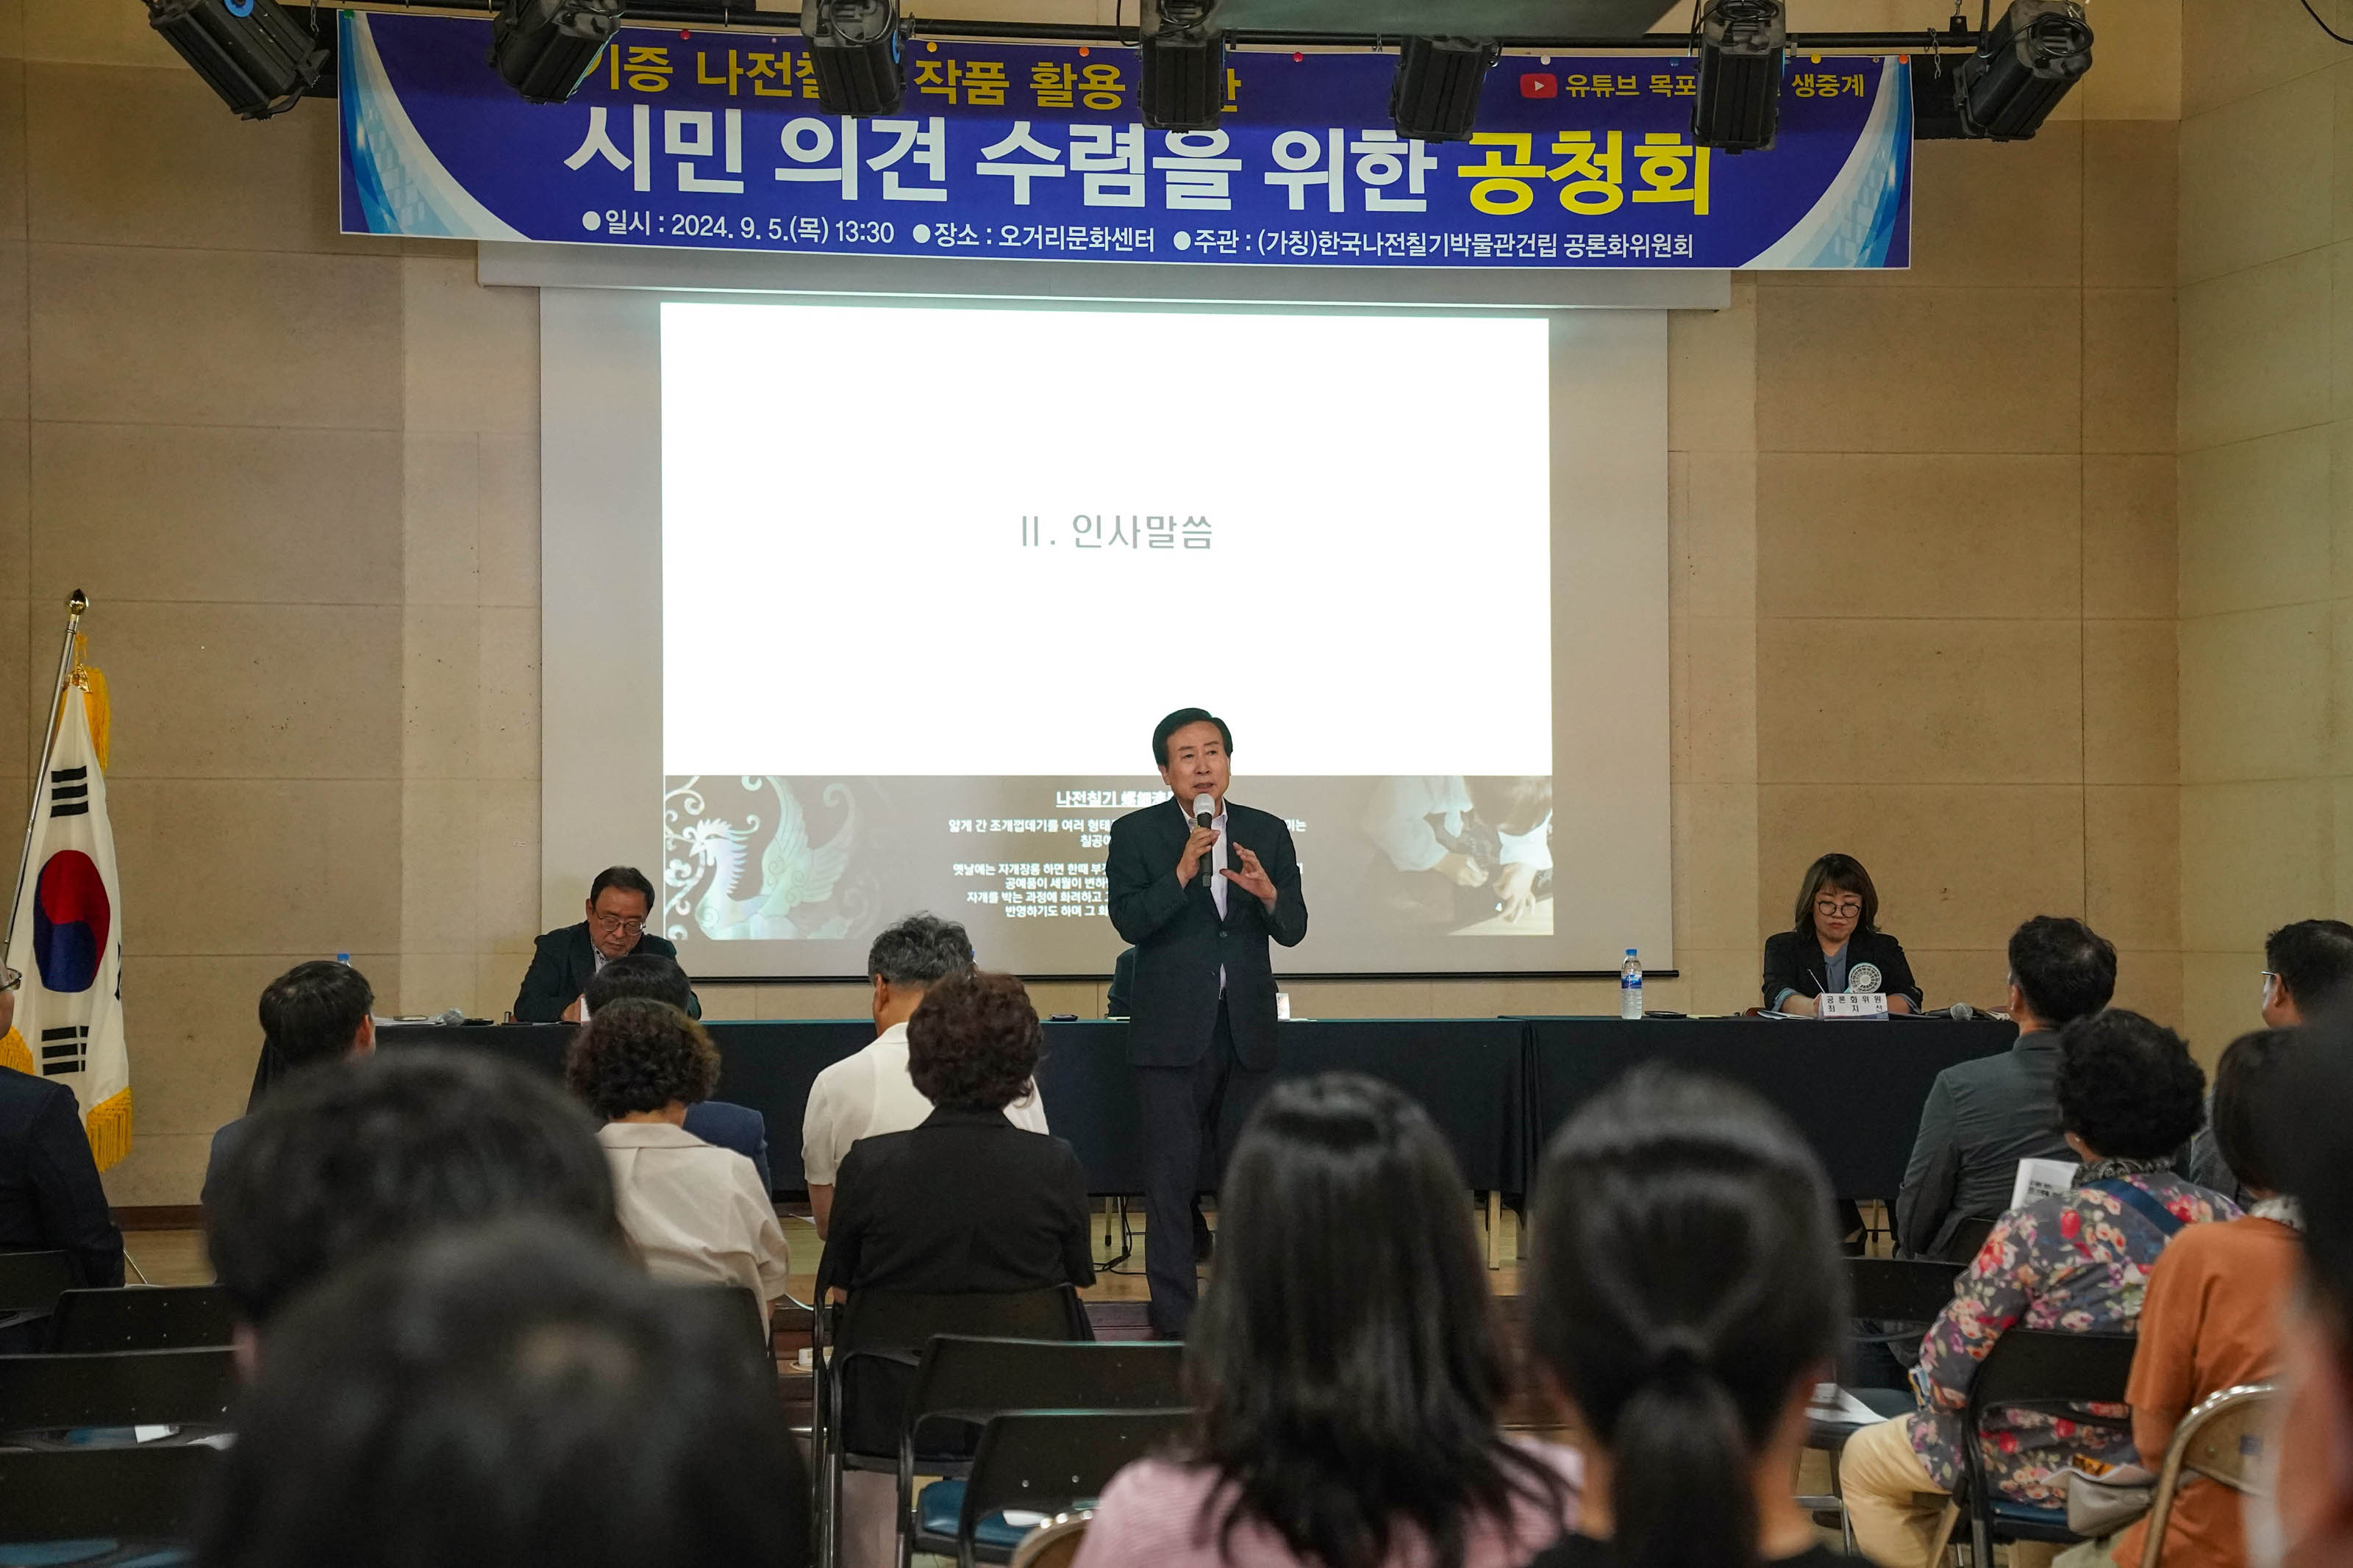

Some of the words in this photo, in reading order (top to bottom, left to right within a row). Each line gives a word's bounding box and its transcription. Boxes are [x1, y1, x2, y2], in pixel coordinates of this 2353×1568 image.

[914, 60, 1010, 105] 작품
[1030, 62, 1126, 110] 활용
[1565, 74, 1640, 98] 유튜브
[1791, 74, 1864, 98] 생중계
[564, 104, 744, 193] 시민
[775, 115, 948, 201] 의견
[976, 121, 1242, 210] 수렴을
[1264, 128, 1438, 212] 위한
[1457, 130, 1710, 215] 공청회
[671, 214, 734, 239] 2024.
[740, 217, 761, 240] 9.
[835, 220, 895, 243] 13:30
[999, 225, 1154, 252] 오거리문화센터
[1258, 229, 1557, 258] (가칭)한국나전칠기박물관건립
[1564, 232, 1693, 259] 공론화위원회
[1073, 515, 1213, 549] 인사말씀
[1056, 790, 1117, 807] 나전칠기
[975, 819, 987, 832] 간
[1062, 819, 1085, 832] 여러
[1088, 819, 1113, 832] 형태
[953, 863, 996, 876] 옛날에는
[1043, 863, 1064, 876] 하면
[1005, 877, 1047, 889] 공예품이
[1050, 877, 1082, 889] 세월이
[1085, 877, 1108, 889] 변하
[966, 891, 999, 904] 자개를
[1001, 891, 1023, 903] 박는
[1026, 891, 1057, 903] 과정에
[1060, 891, 1102, 903] 화려하고
[1005, 905, 1058, 917] 반영하기도
[1060, 905, 1082, 917] 하며
[1085, 905, 1096, 916] 그
